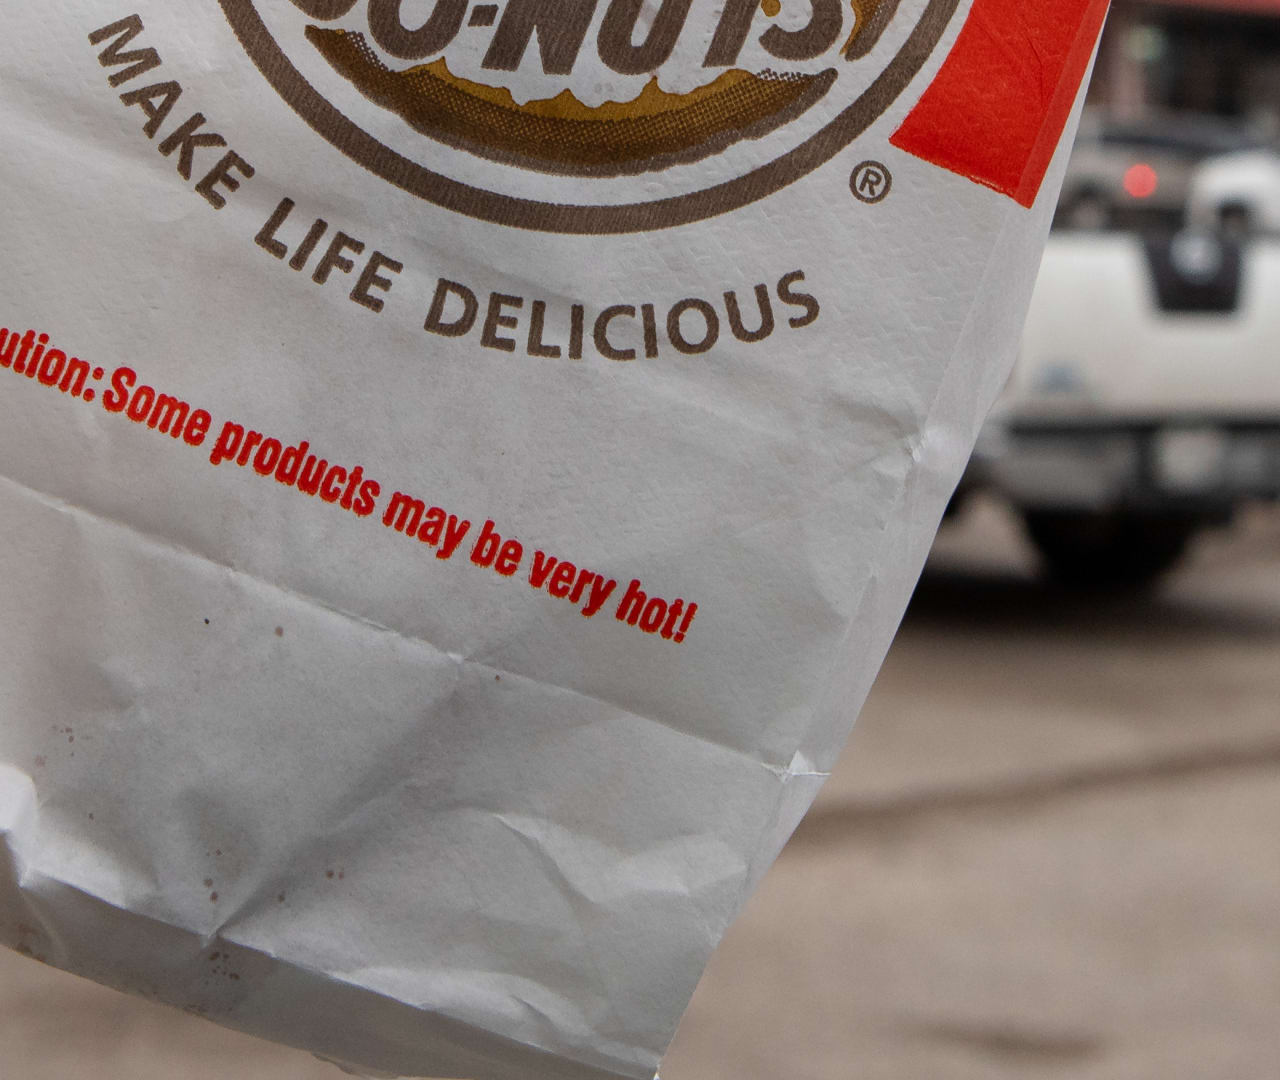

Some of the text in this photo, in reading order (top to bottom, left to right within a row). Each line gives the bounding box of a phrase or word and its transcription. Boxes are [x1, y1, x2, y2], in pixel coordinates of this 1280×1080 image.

[87, 12, 822, 362] MAKE LIFE DELICIOUS
[102, 366, 214, 448] Some
[210, 422, 382, 518] products
[382, 491, 473, 563] may
[470, 520, 526, 578] be
[528, 551, 619, 619] very
[615, 579, 700, 645] hot!
